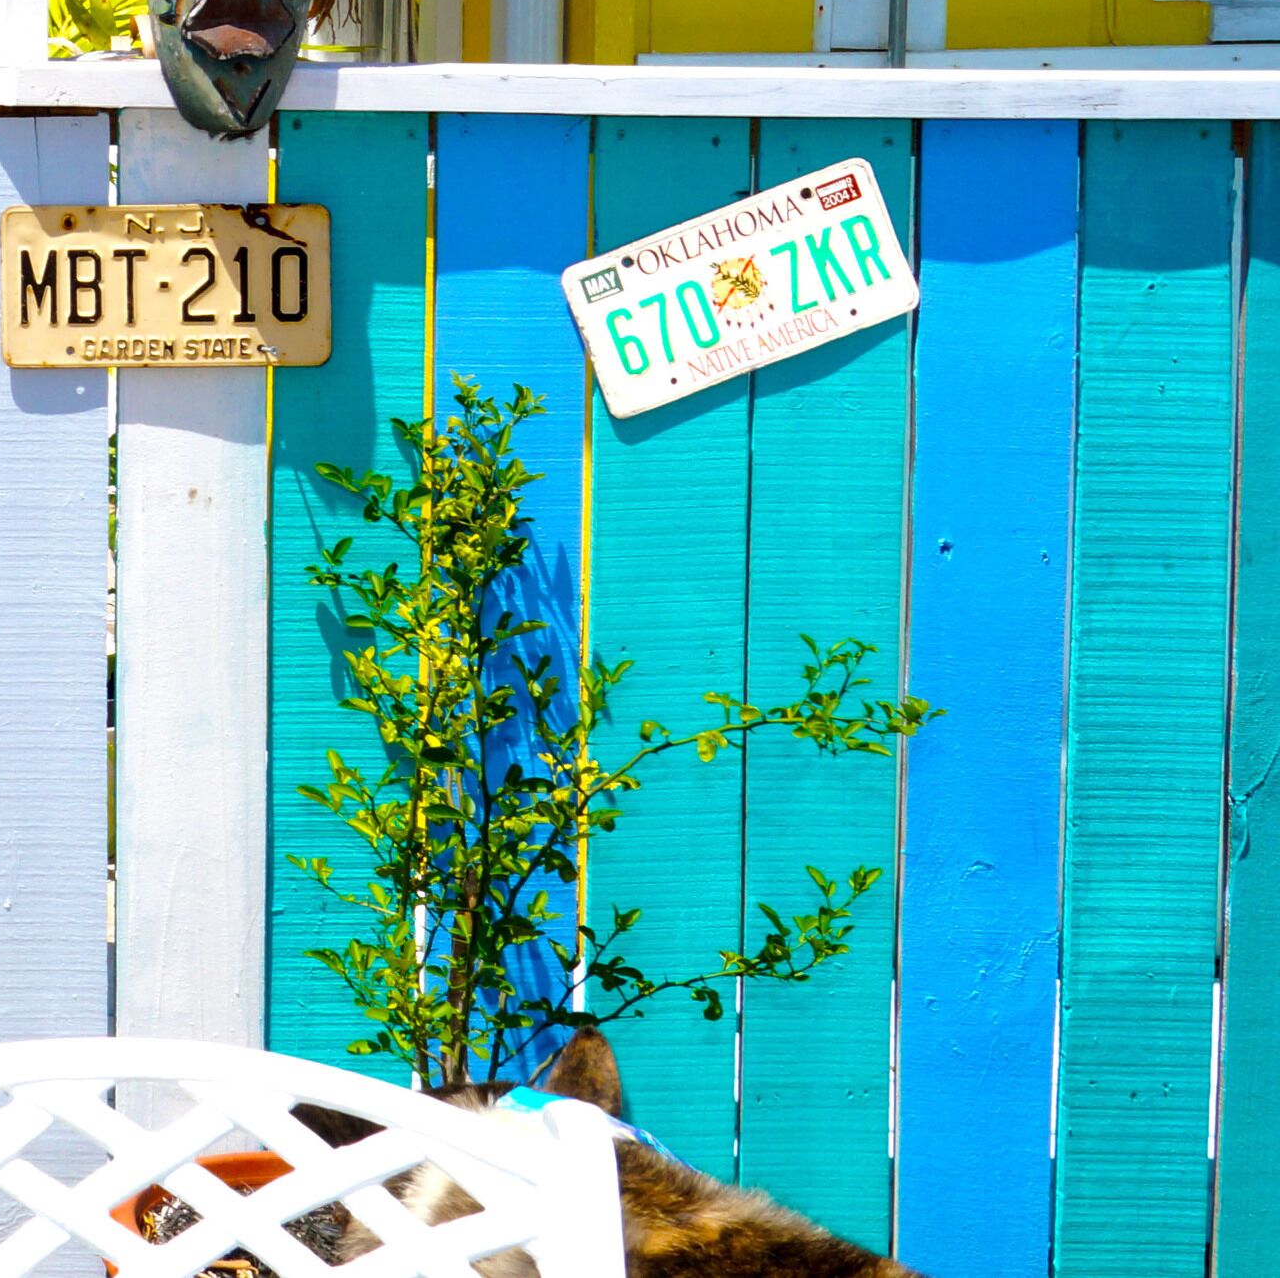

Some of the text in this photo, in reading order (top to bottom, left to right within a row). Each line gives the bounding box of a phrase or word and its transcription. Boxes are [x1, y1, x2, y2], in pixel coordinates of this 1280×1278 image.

[822, 189, 850, 209] 2004
[634, 194, 803, 276] OKLAHOMA
[584, 270, 616, 296] MAY
[605, 213, 892, 376] 670 ZKR
[80, 337, 254, 362] GARDEN STATE
[686, 309, 840, 383] NATIVE AMERICA
